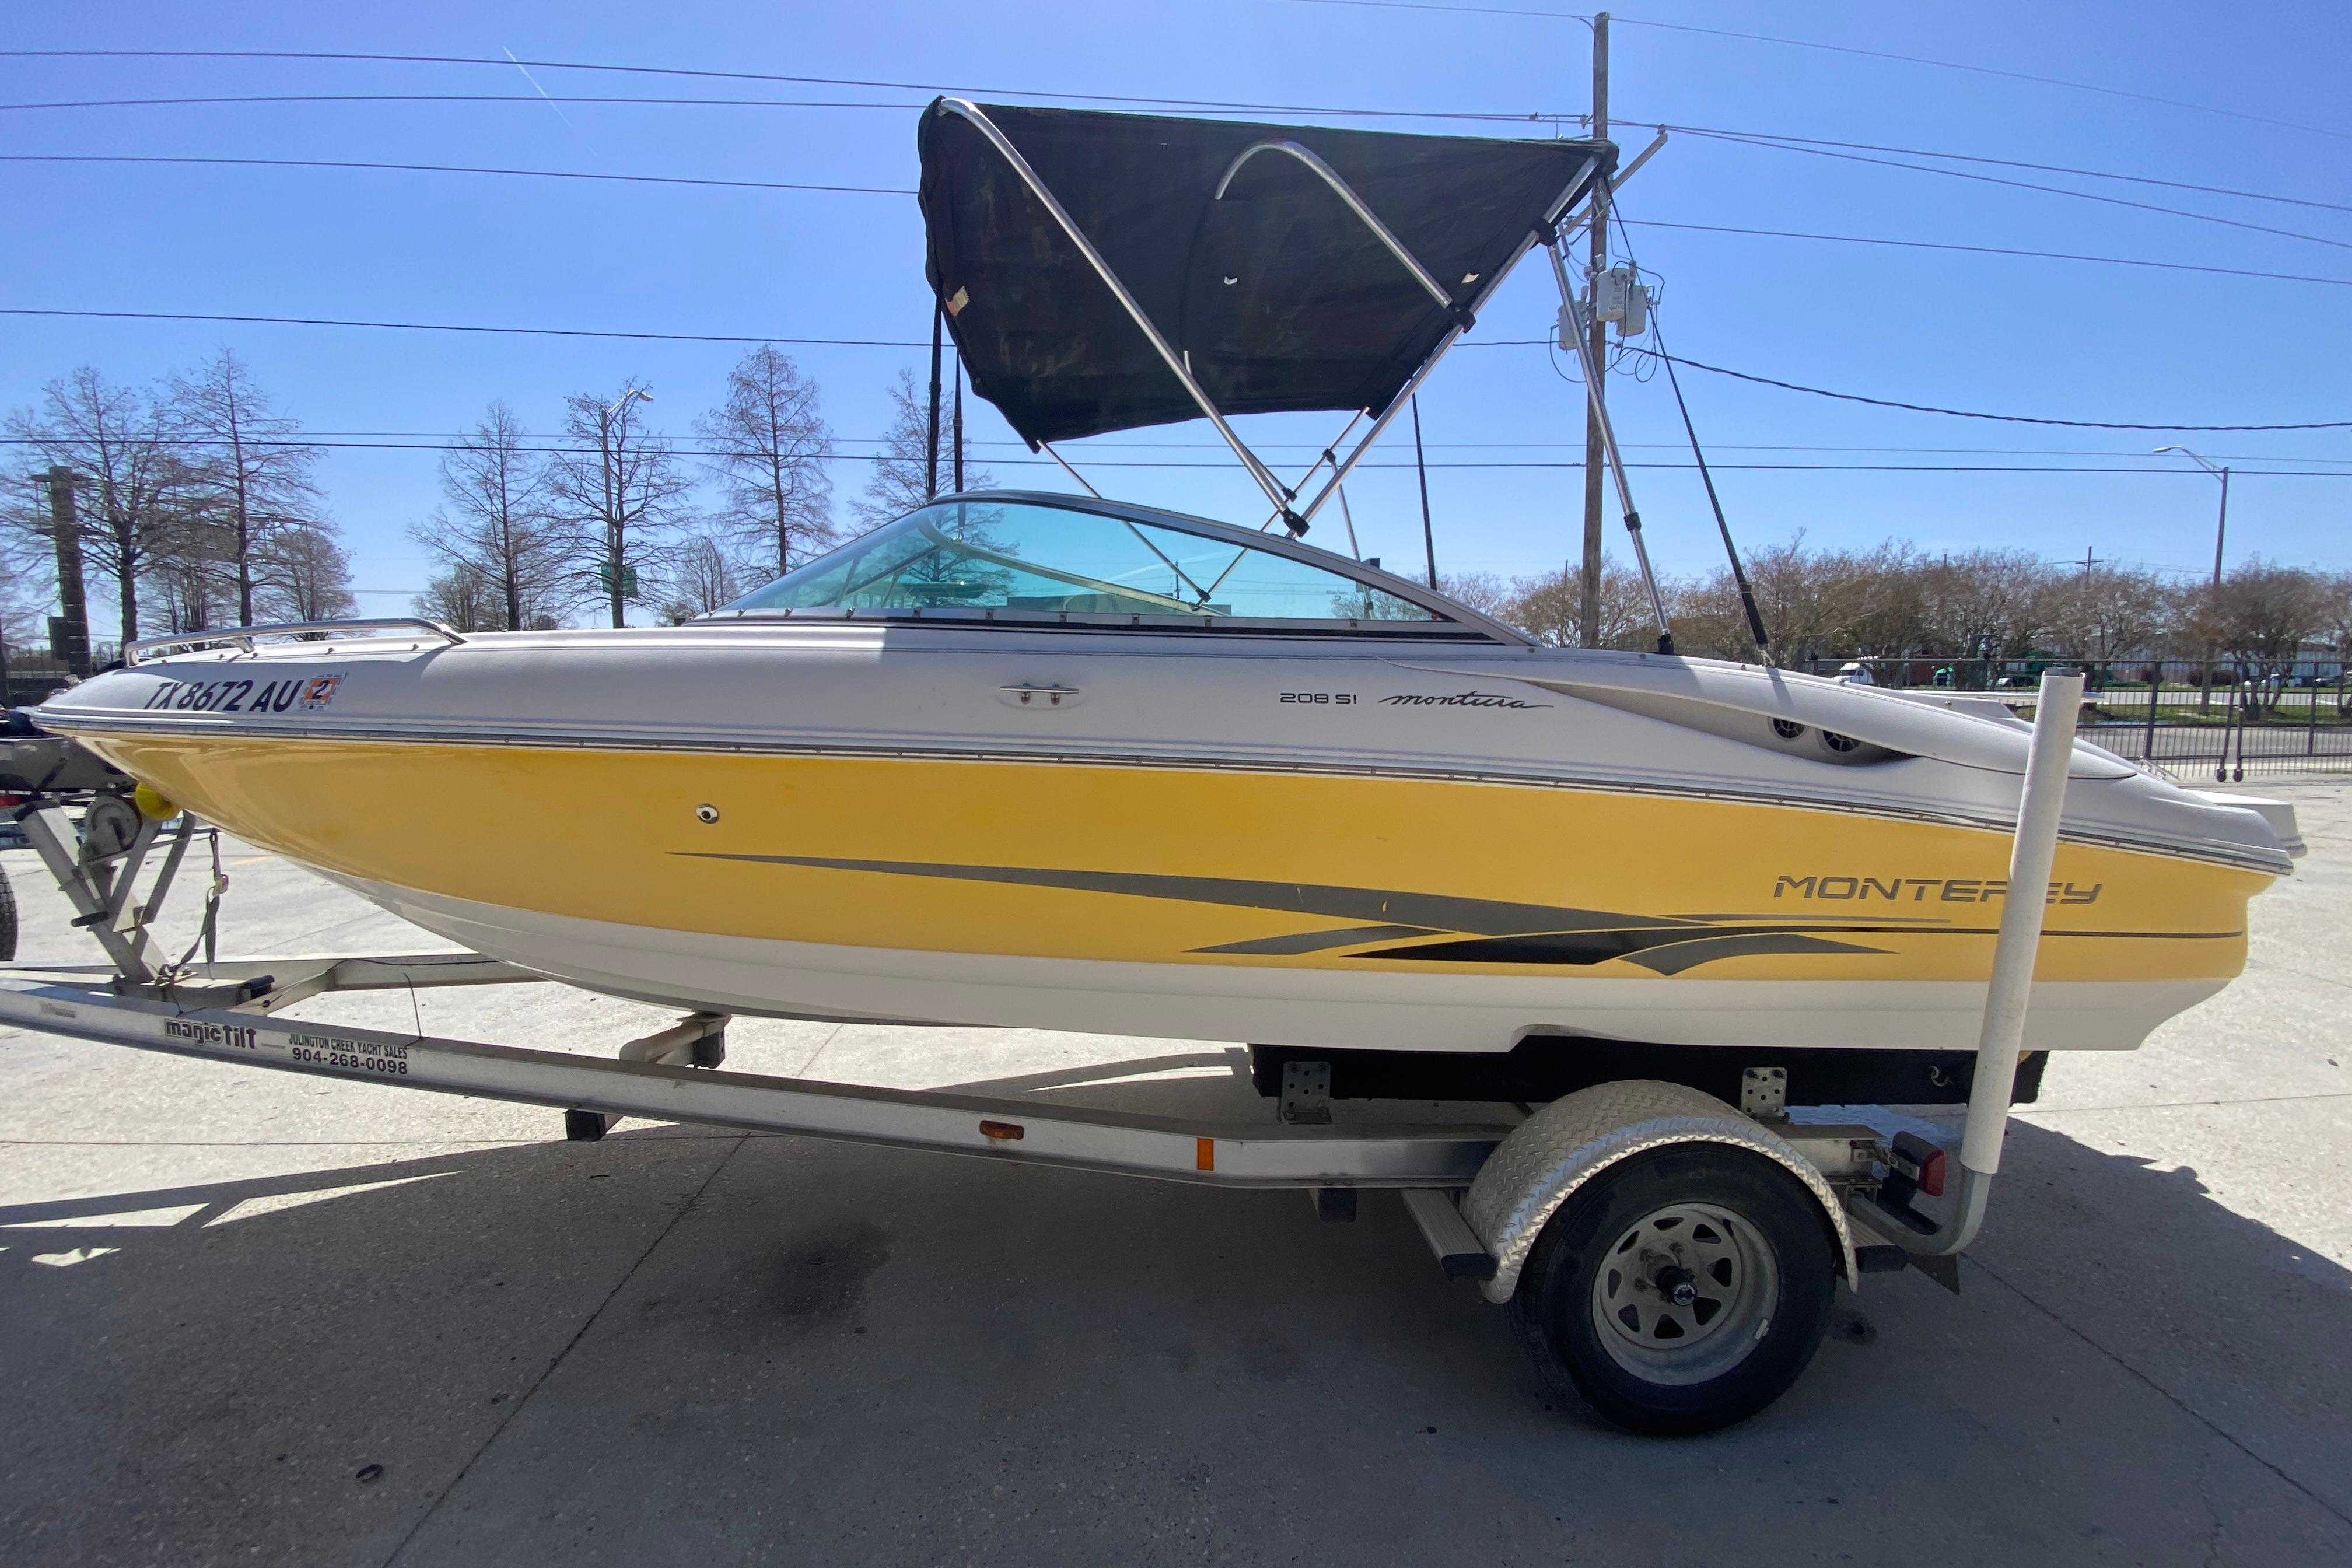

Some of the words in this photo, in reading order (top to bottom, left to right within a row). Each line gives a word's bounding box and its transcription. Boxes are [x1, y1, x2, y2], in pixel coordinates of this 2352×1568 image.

[176, 680, 253, 711] 8672
[249, 680, 304, 712] AU
[1280, 692, 1329, 704] 208
[1335, 694, 1357, 705] SI
[1773, 876, 2102, 904] MONTEY
[288, 1033, 330, 1049] JULINGTON
[331, 1038, 356, 1054] CREEK
[357, 1041, 382, 1056] YACHT
[384, 1045, 408, 1059] SALES
[292, 1047, 408, 1075] 904-268-0098
